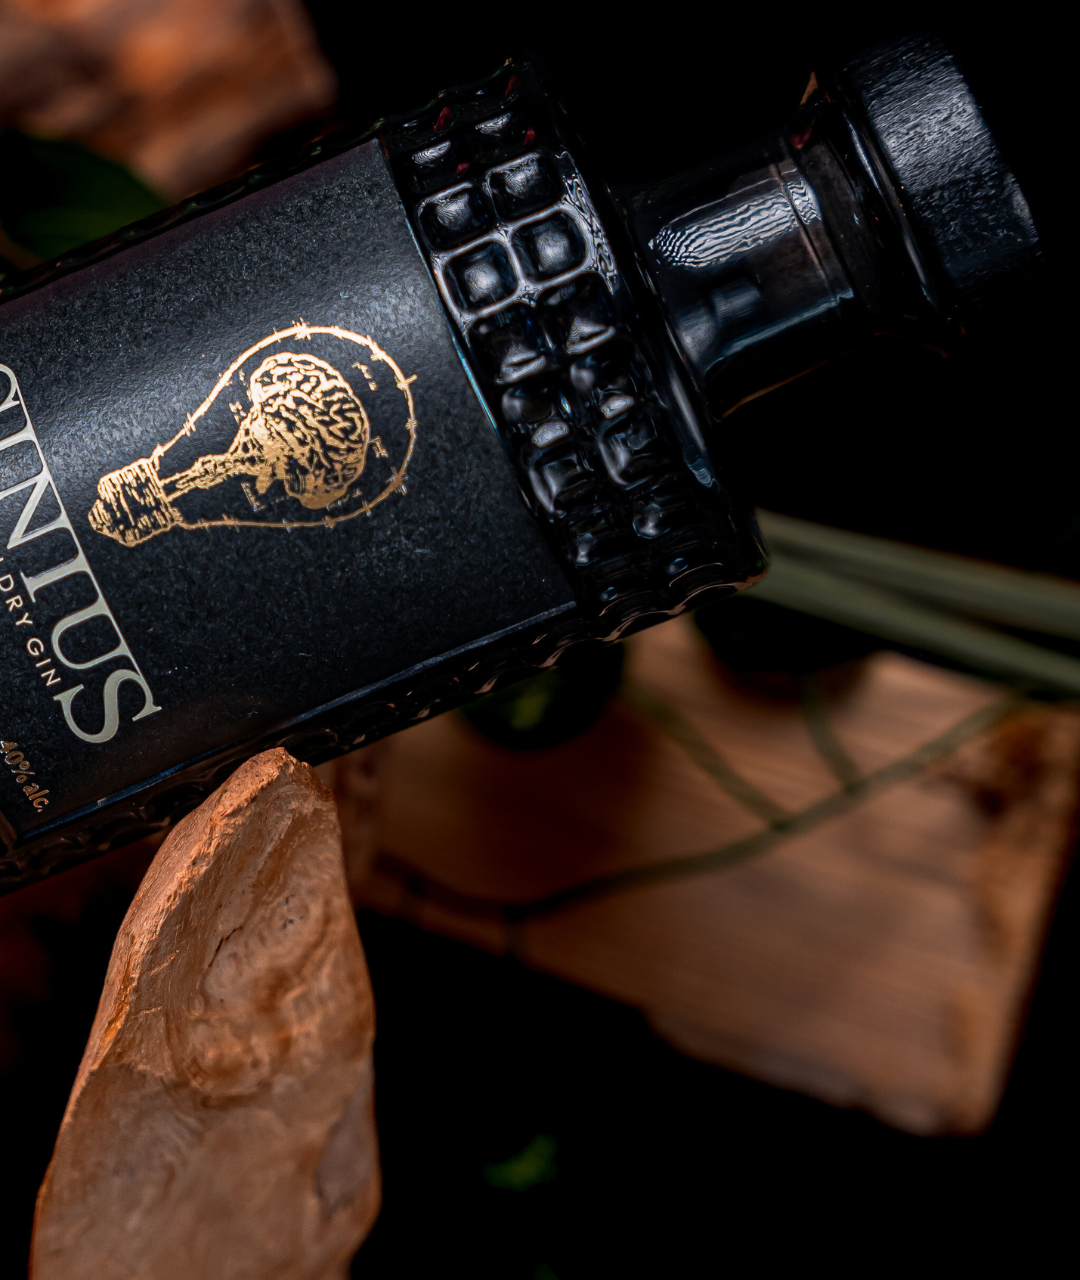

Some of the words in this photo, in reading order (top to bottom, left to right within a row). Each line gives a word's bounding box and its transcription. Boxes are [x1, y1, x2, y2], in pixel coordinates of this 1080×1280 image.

[26, 637, 62, 687] GIN
[0, 740, 36, 784] 40%
[22, 782, 50, 813] alc.
